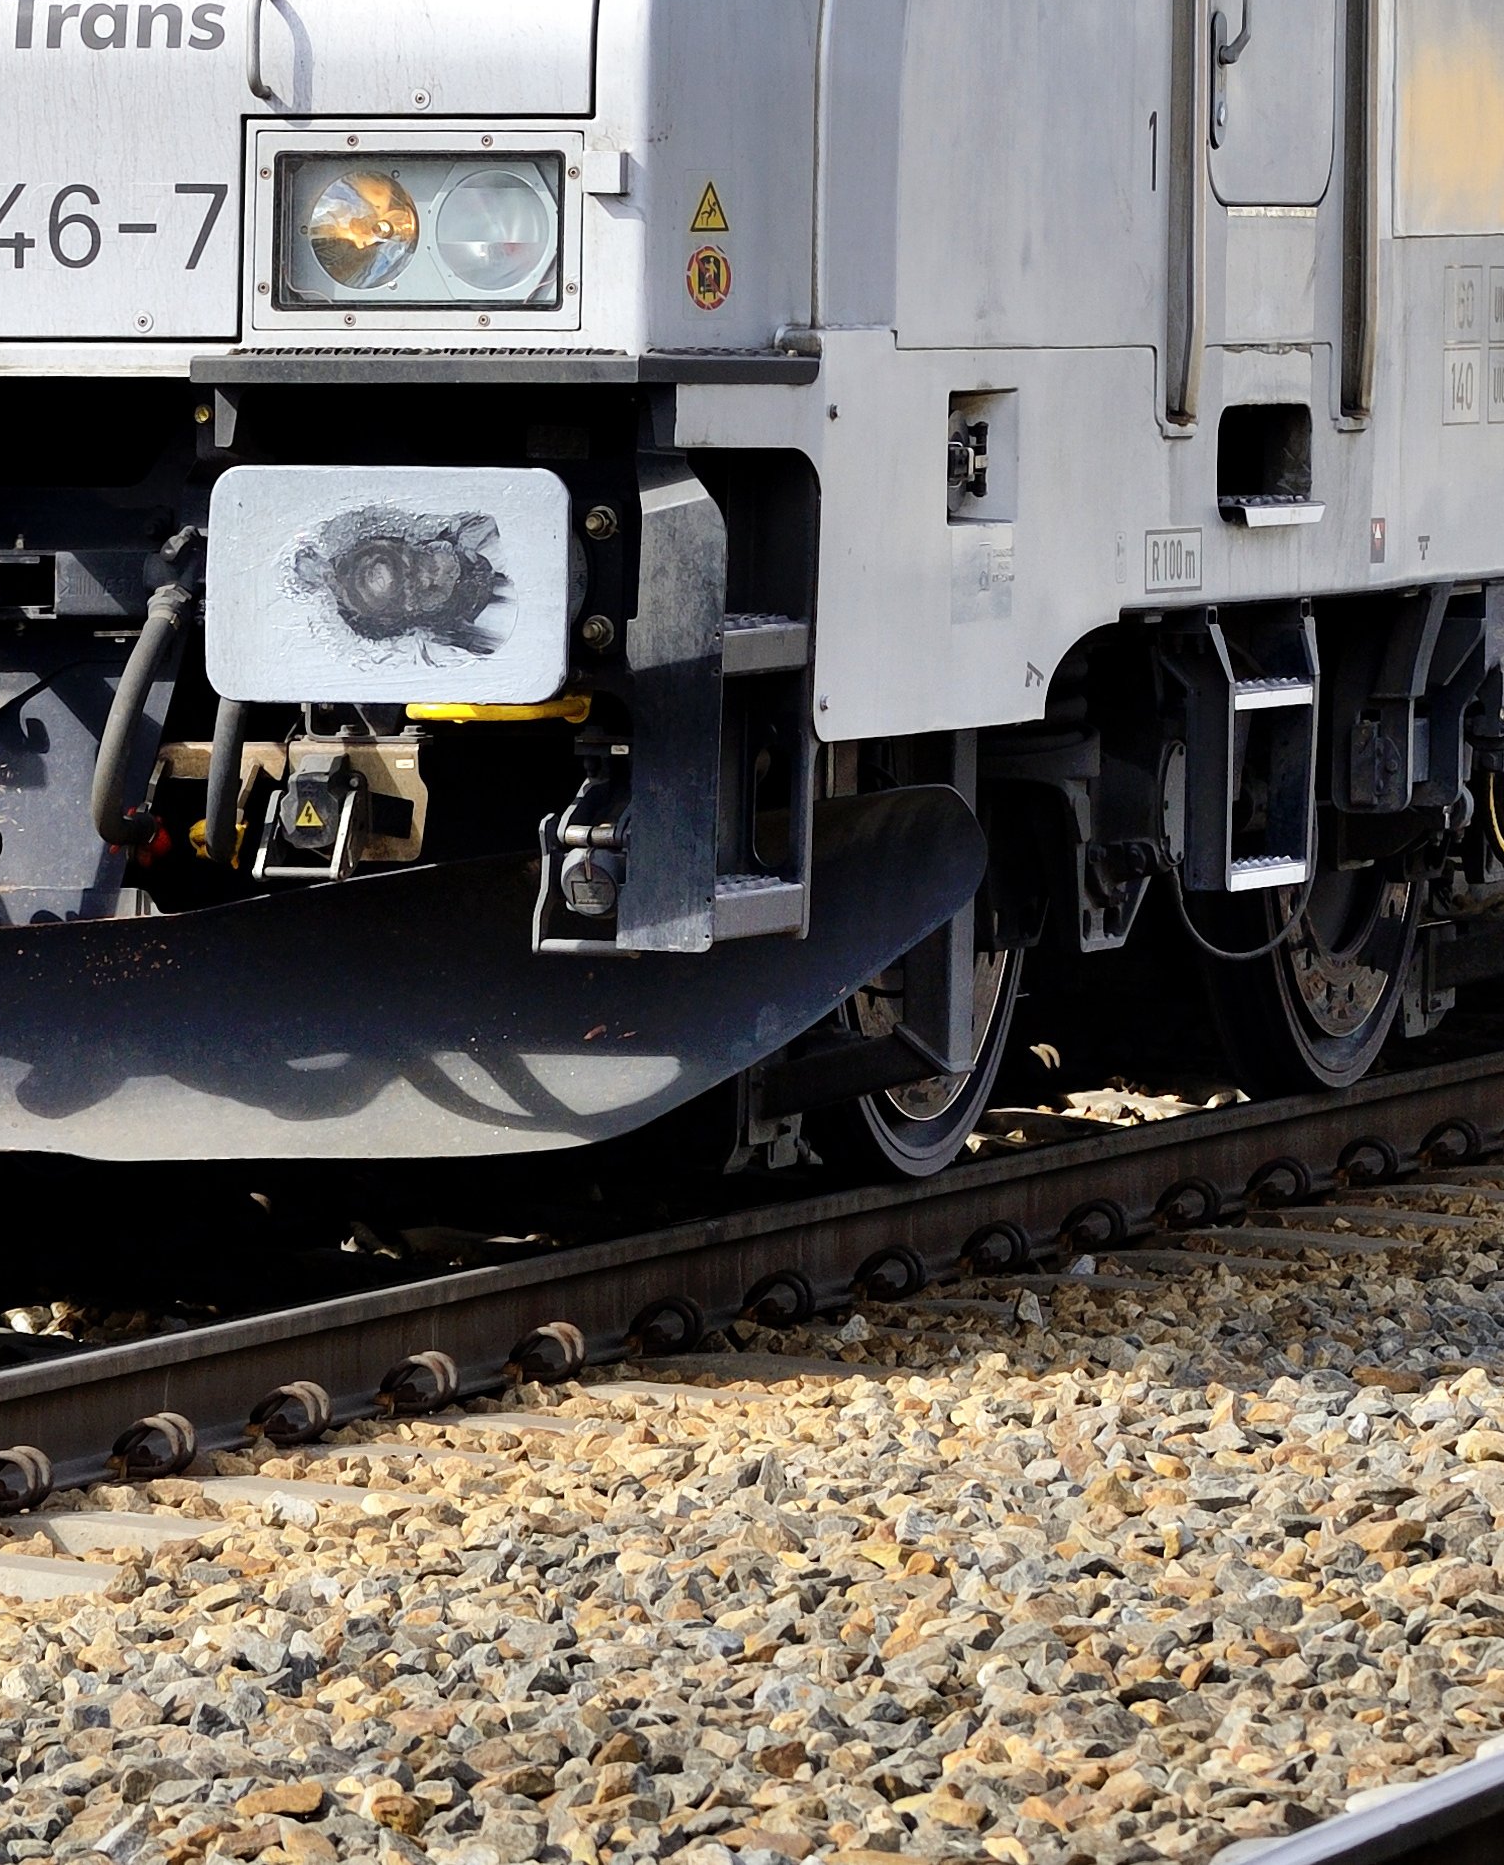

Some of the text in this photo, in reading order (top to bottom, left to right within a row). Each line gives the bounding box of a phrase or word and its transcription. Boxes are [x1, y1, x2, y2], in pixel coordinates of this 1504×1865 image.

[1451, 362, 1474, 411] 140
[1152, 539, 1195, 582] R 100 m
